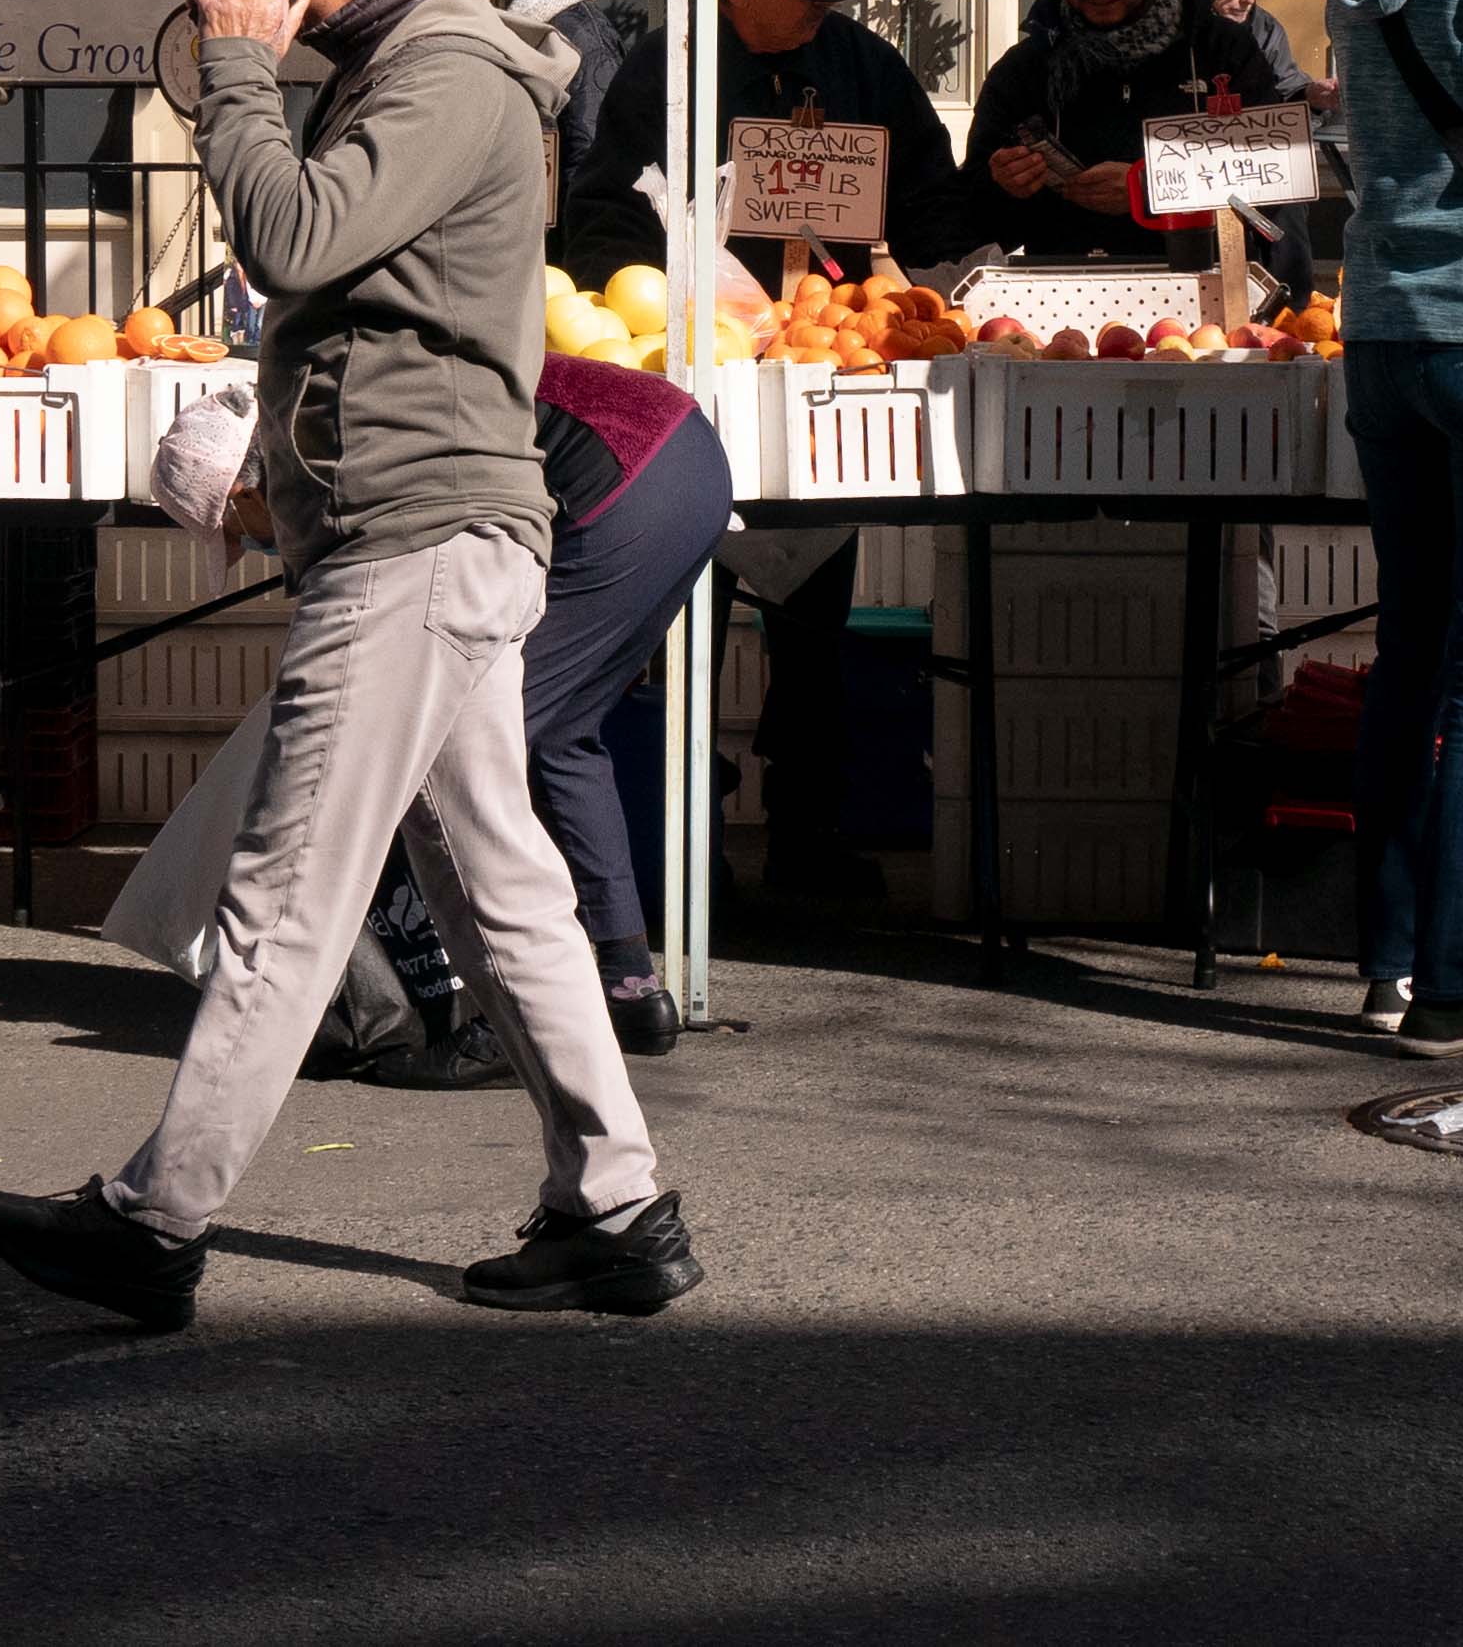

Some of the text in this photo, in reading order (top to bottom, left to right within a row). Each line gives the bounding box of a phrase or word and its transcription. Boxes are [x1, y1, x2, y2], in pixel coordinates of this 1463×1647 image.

[1154, 111, 1299, 142] ORGANIC
[738, 126, 879, 155] ORGANIC
[1157, 129, 1293, 162] APPLES
[802, 152, 877, 166] MANDARINS
[830, 171, 861, 196] LB
[1155, 168, 1188, 187] PINK
[1156, 186, 1191, 202] LADY
[745, 198, 851, 223] SWEET
